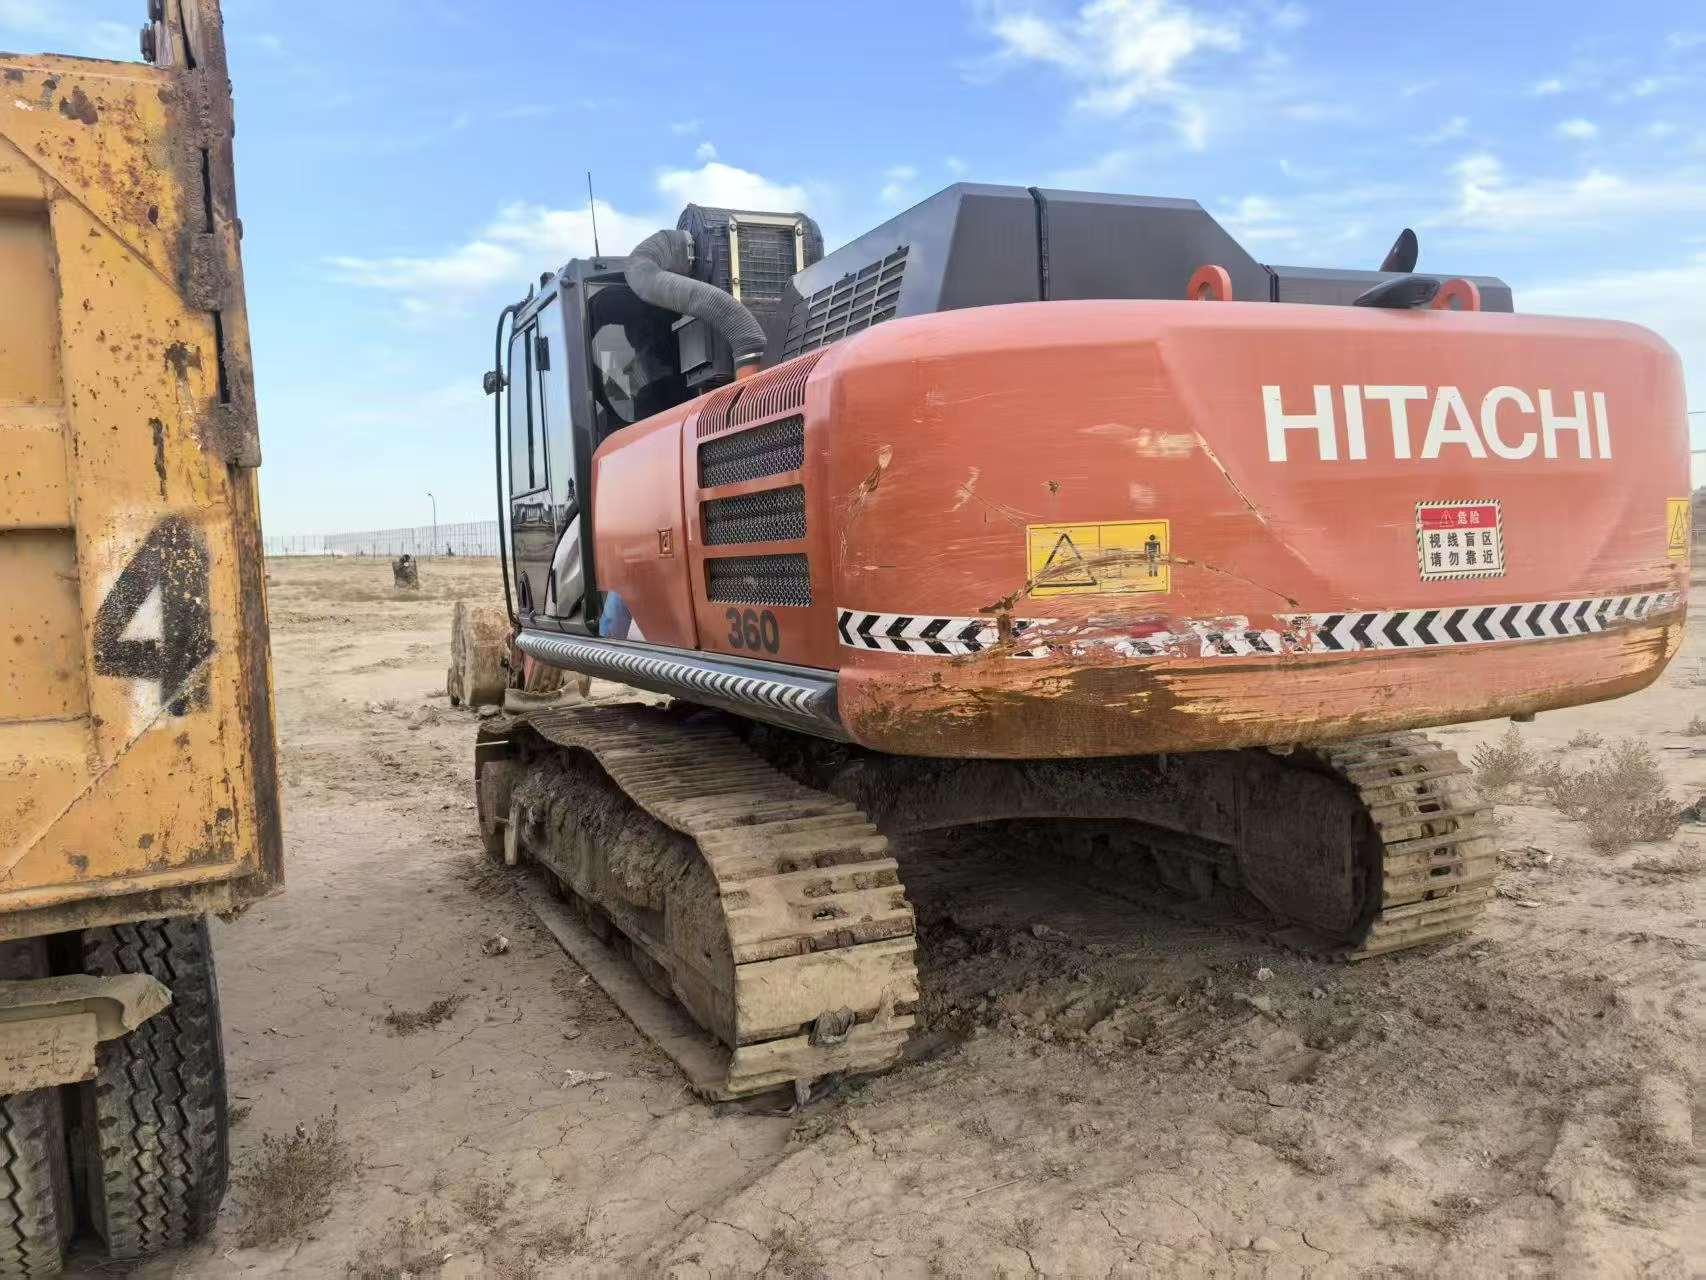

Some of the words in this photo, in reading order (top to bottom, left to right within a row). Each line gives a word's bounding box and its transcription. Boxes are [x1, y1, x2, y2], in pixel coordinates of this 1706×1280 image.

[1262, 384, 1612, 462] HITACHI
[1457, 510, 1480, 525] 危险
[1429, 531, 1492, 548] 视线盲区
[1431, 550, 1493, 567] 请勿靠近
[93, 512, 218, 717] 4
[726, 606, 780, 655] 360
